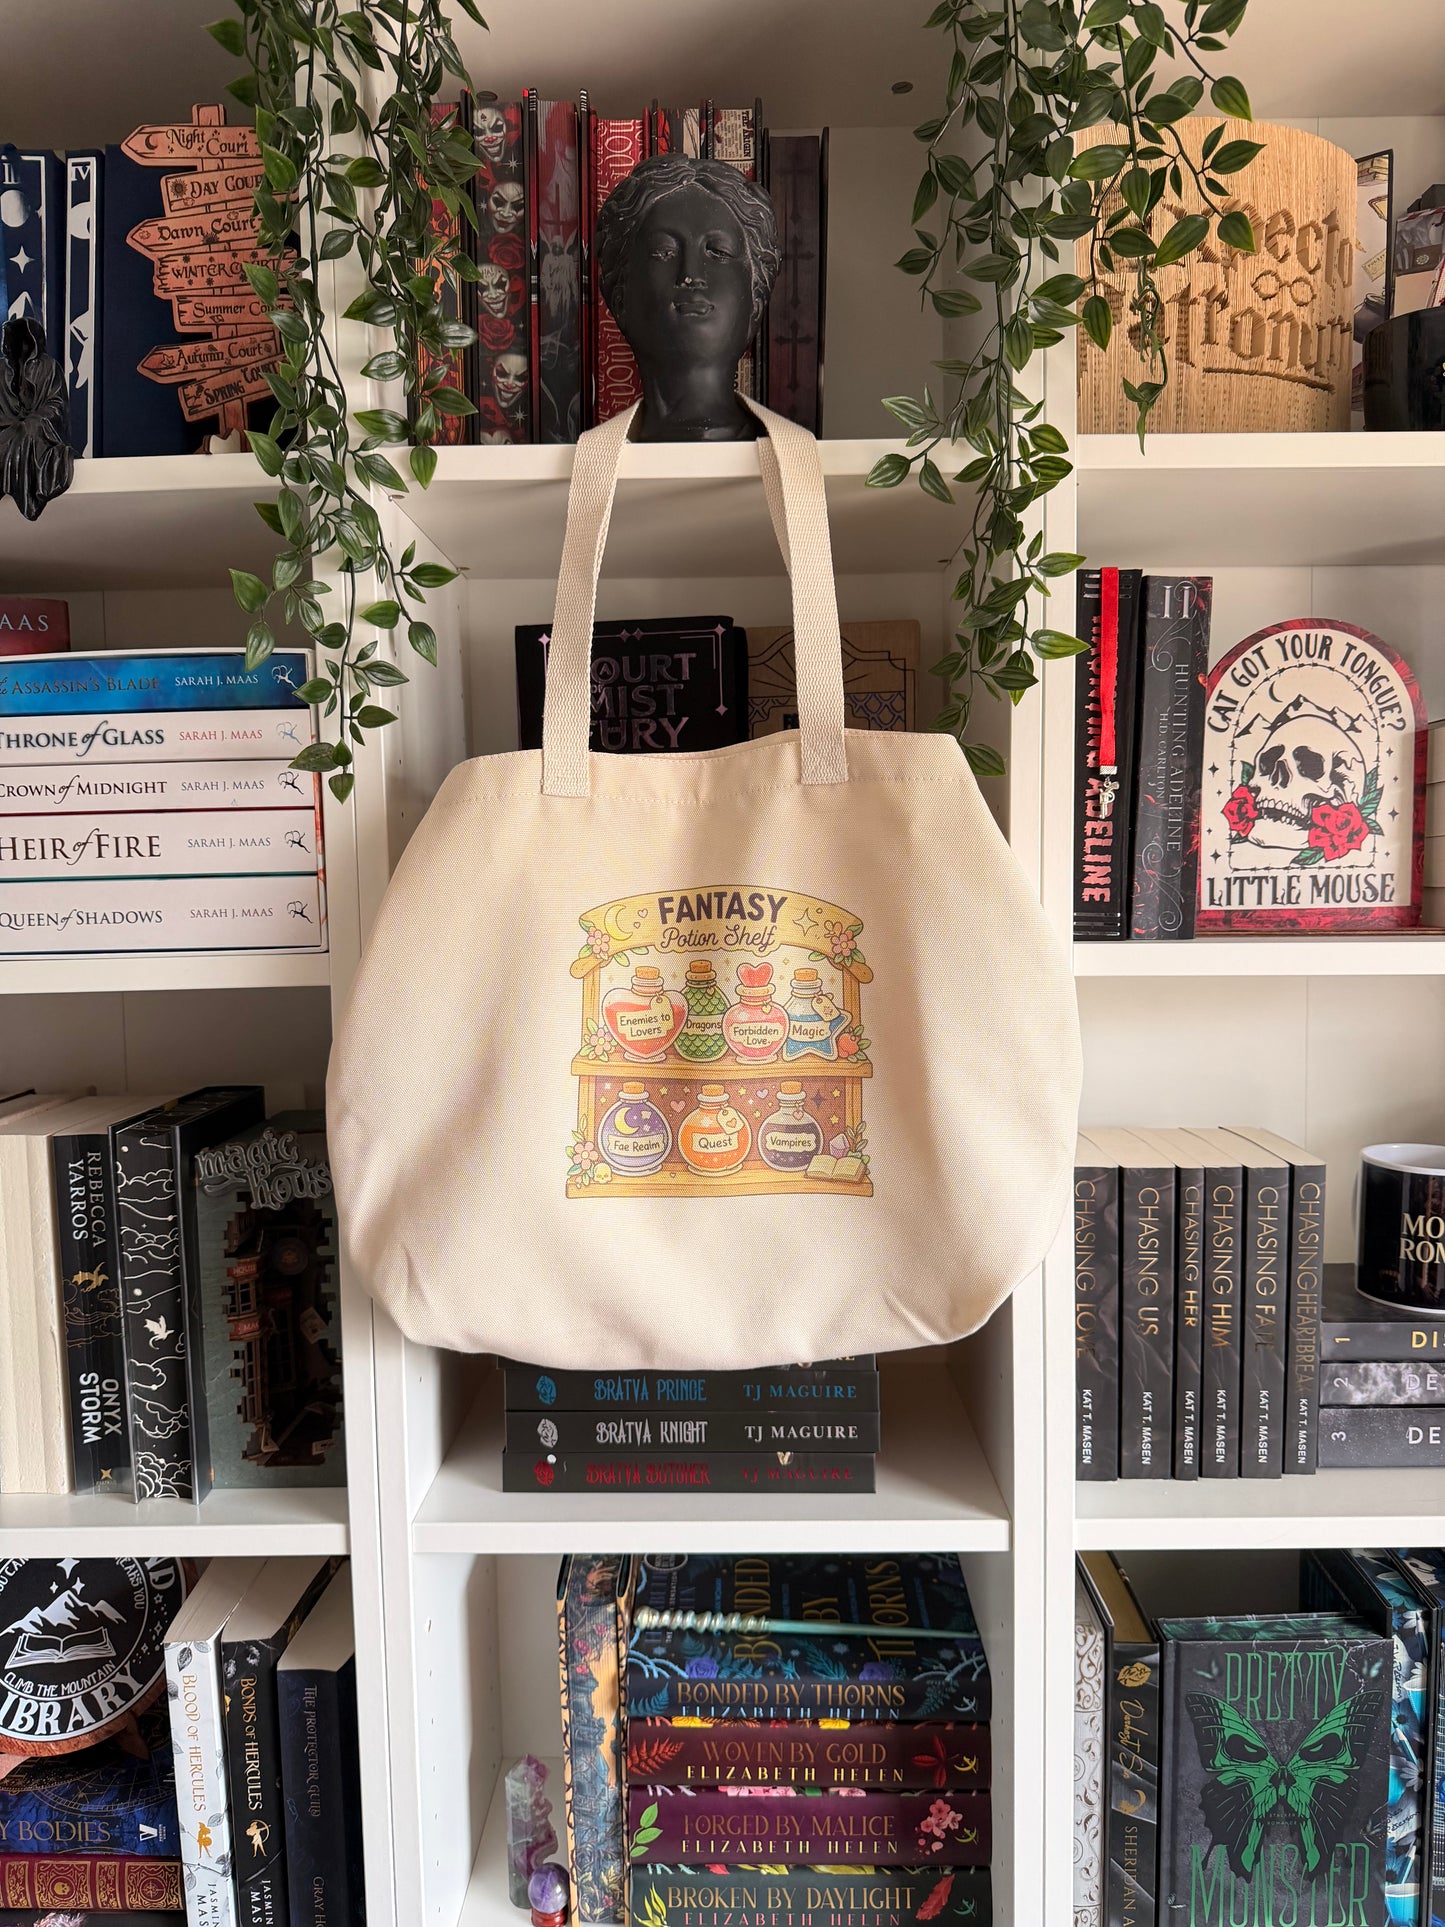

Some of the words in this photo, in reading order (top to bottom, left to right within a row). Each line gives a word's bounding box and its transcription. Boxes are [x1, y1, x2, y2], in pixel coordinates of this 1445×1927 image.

[165, 128, 205, 149] Night
[205, 138, 249, 156] Court
[190, 180, 219, 199] DAY
[224, 174, 263, 192] COUR
[157, 225, 203, 241] Dawn
[210, 217, 256, 234] Court
[172, 263, 233, 279] WINTER
[193, 302, 245, 318] Summer
[176, 350, 224, 366] Autumn
[228, 342, 263, 359] Court
[204, 381, 245, 405] SPRING
[175, 676, 213, 687] SARAH
[215, 676, 223, 687] J.
[226, 674, 259, 685] MAAS
[590, 653, 697, 684] OURT
[12, 676, 100, 694] ASSASSIN'S
[107, 677, 160, 691] BLADE
[1207, 689, 1239, 733] CAT
[1230, 646, 1270, 688] GOT
[1275, 633, 1333, 662] YOUR
[1340, 642, 1407, 732] TONGUE?
[590, 683, 684, 718] MIST
[1171, 664, 1189, 757] HUNTING
[179, 731, 217, 742] SARAH
[220, 730, 228, 742] J.
[230, 729, 263, 740] MAAS
[1158, 713, 1169, 736] H.D.
[76, 720, 108, 757] of
[102, 728, 165, 746] GLASS
[1155, 740, 1167, 799] CARLTON
[54, 774, 80, 804] of
[76, 781, 168, 796] MIDNIGHT
[181, 781, 220, 792] SARAH
[222, 780, 230, 792] J.
[232, 780, 265, 790] MAAS
[1166, 765, 1184, 852] ADELINE
[0, 836, 72, 861] HEIR
[66, 828, 100, 865] of
[95, 833, 162, 859] FIRE
[187, 838, 226, 849] SARAH
[228, 837, 236, 849] J.
[238, 836, 271, 847] MAAS
[1206, 874, 1301, 907] LITTLE
[1309, 872, 1395, 904] MOUSE
[0, 912, 59, 931] QUEEN
[57, 909, 77, 931] of
[76, 910, 163, 925] SHADOWS
[190, 909, 229, 920] SARAH
[230, 907, 239, 920] J.
[241, 907, 274, 918] MAAS
[657, 891, 788, 925] FANTASY
[660, 927, 719, 949] Potion
[724, 924, 778, 951] Shelf
[619, 1014, 659, 1027] Enemies
[660, 1013, 671, 1023] to
[629, 1025, 662, 1037] Lovers
[686, 1019, 721, 1032] Dragons
[733, 1026, 779, 1037] Forbidden
[791, 1024, 825, 1038] Magic
[613, 1140, 630, 1151] Fae
[632, 1139, 660, 1151] Realm
[698, 1137, 733, 1149] Quest
[770, 1136, 812, 1149] Vampires
[68, 1160, 88, 1241] YARROS
[87, 1151, 107, 1248] REBECCA
[1074, 1180, 1096, 1292] CHASING
[1137, 1187, 1160, 1296] CHASING
[1184, 1186, 1200, 1282] CHASING
[1212, 1185, 1234, 1295] CHASING
[1255, 1186, 1279, 1296] CHASING
[1296, 1182, 1321, 1291] CHASING
[1184, 1290, 1199, 1328] HER
[1075, 1303, 1097, 1359] LOVE
[1137, 1306, 1160, 1337] US
[1211, 1304, 1232, 1348] HIM
[594, 1375, 648, 1403] BRATVA
[657, 1378, 707, 1402] PRINCE
[743, 1384, 762, 1400] TJ
[769, 1385, 857, 1399] MAGUIRE
[1333, 1377, 1348, 1388] 2
[79, 1372, 101, 1445] STORM
[100, 1379, 122, 1436] ONYX
[1082, 1389, 1092, 1412] KAT
[1142, 1391, 1153, 1412] KAT
[1185, 1390, 1195, 1412] KAT
[1216, 1389, 1226, 1411] KAT
[1259, 1390, 1269, 1412] KAT
[1299, 1398, 1308, 1418] KAT
[1082, 1412, 1092, 1423] T.
[1142, 1413, 1152, 1424] T.
[1184, 1413, 1194, 1424] T.
[1216, 1412, 1226, 1423] T.
[1258, 1412, 1268, 1423] T.
[1299, 1418, 1307, 1427] T.
[596, 1418, 652, 1446] BRATVA
[660, 1421, 707, 1444] KNIGHT
[744, 1425, 762, 1441] TJ
[771, 1425, 858, 1439] MAGUIRE
[1215, 1424, 1226, 1463] MASEN
[1331, 1431, 1346, 1441] 3
[1082, 1425, 1092, 1464] MASEN
[1141, 1426, 1152, 1465] MASEN
[1183, 1426, 1194, 1464] MASEN
[1257, 1425, 1268, 1464] MASEN
[1297, 1430, 1307, 1464] MASEN
[585, 1460, 641, 1487] BRATVA
[645, 1462, 711, 1486] BUTCHER
[767, 1468, 854, 1480] MAGUIRE
[133, 1587, 145, 1609] YOU
[3, 1671, 34, 1695] CLIMB
[37, 1684, 58, 1697] THE
[61, 1660, 117, 1696] MOUNTAIN
[1224, 1644, 1347, 1721] PRETTY
[182, 1674, 201, 1723] BLOOD
[240, 1677, 258, 1723] BONDS
[303, 1685, 317, 1708] THE
[677, 1683, 768, 1704] BONDED
[776, 1683, 805, 1704] BY
[811, 1684, 906, 1706] THORNS
[681, 1706, 811, 1719] ELIZABETH
[829, 1706, 900, 1720] HELEN
[186, 1724, 200, 1741] OF
[304, 1711, 319, 1784] PROTECTOR
[703, 1740, 787, 1763] WOVEN
[791, 1742, 820, 1763] BY
[827, 1743, 887, 1764] GOLD
[188, 1745, 207, 1812] HERCULES
[245, 1739, 263, 1812] HERCULES
[687, 1765, 816, 1781] ELIZABETH
[834, 1767, 905, 1782] HELEN
[18, 1821, 111, 1842] BODIES
[684, 1814, 769, 1836] FORGED
[776, 1815, 805, 1836] BY
[808, 1815, 896, 1836] MALICE
[681, 1840, 810, 1854] ELIZABETH
[828, 1840, 899, 1854] HELEN
[1123, 1825, 1138, 1910] SHERIDAN
[261, 1879, 274, 1925] JASMIN
[312, 1876, 325, 1911] GRAY
[667, 1886, 757, 1910] BROKEN
[767, 1887, 797, 1910] BY
[806, 1886, 916, 1910] DAYLIGHT
[684, 1912, 813, 1926] ELIZABETH
[830, 1912, 900, 1926] HELEN
